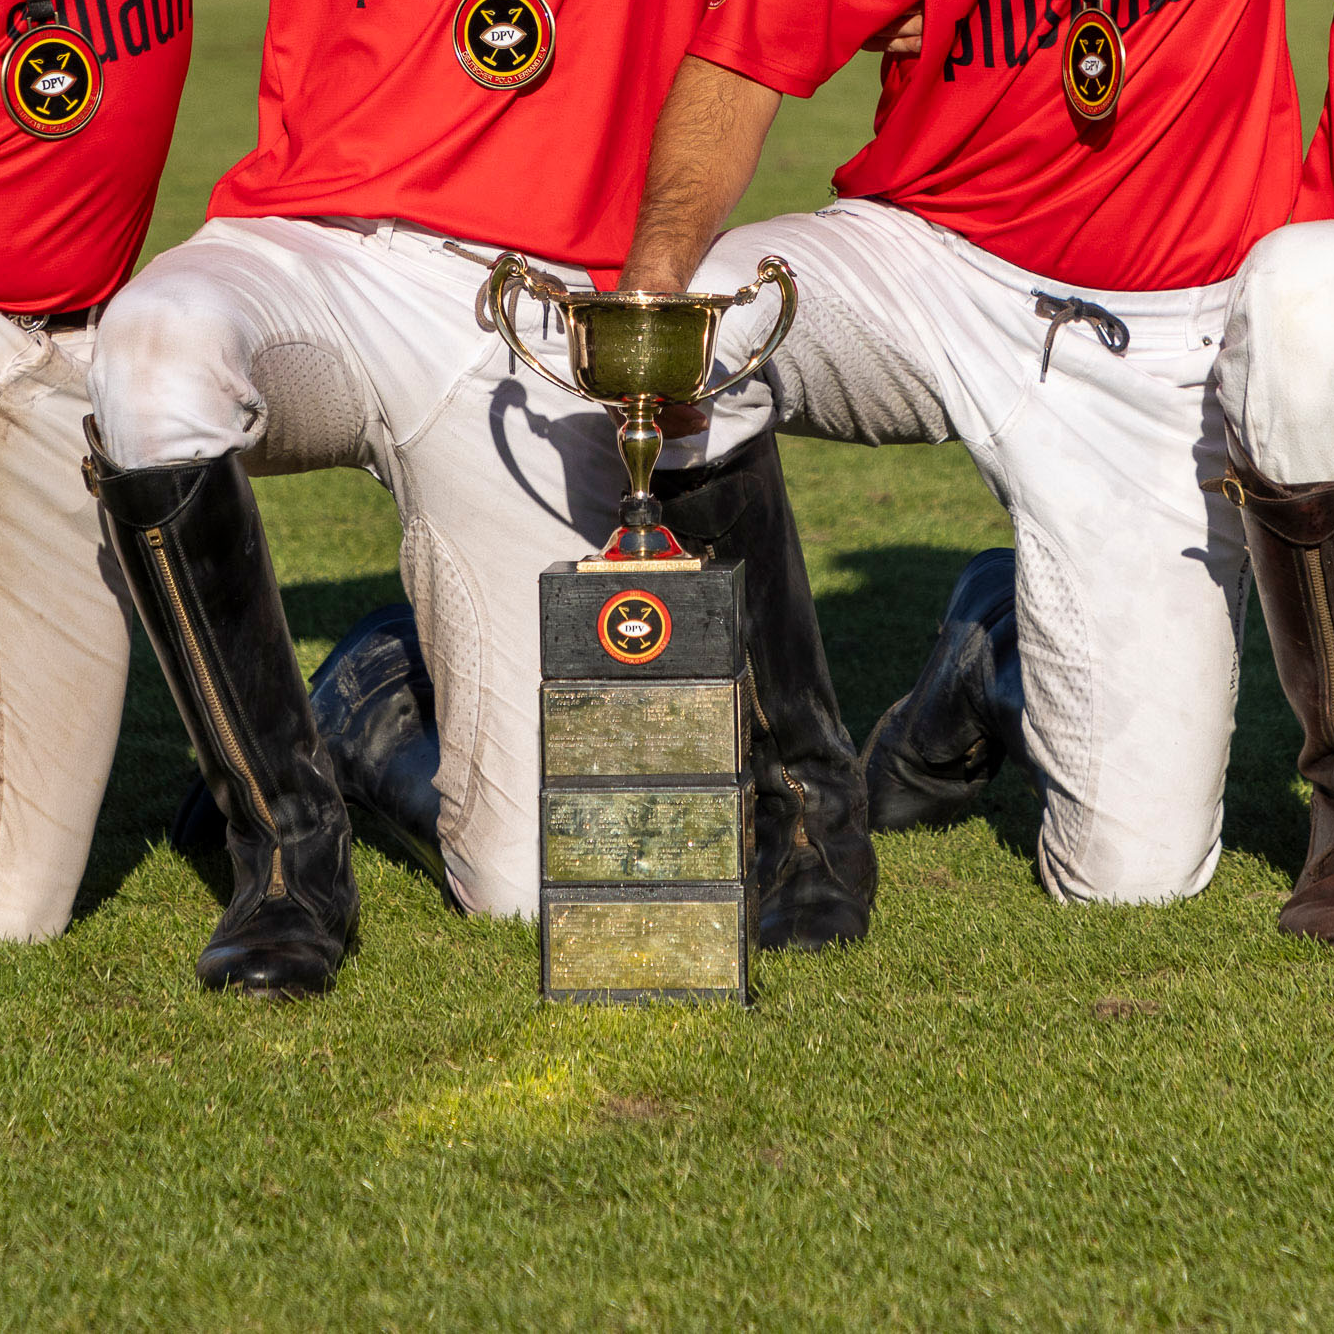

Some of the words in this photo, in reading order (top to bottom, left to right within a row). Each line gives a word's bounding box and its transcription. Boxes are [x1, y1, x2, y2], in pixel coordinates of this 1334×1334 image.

[491, 31, 515, 41] DPV
[42, 76, 66, 90] DPV
[625, 625, 645, 633] DPV
